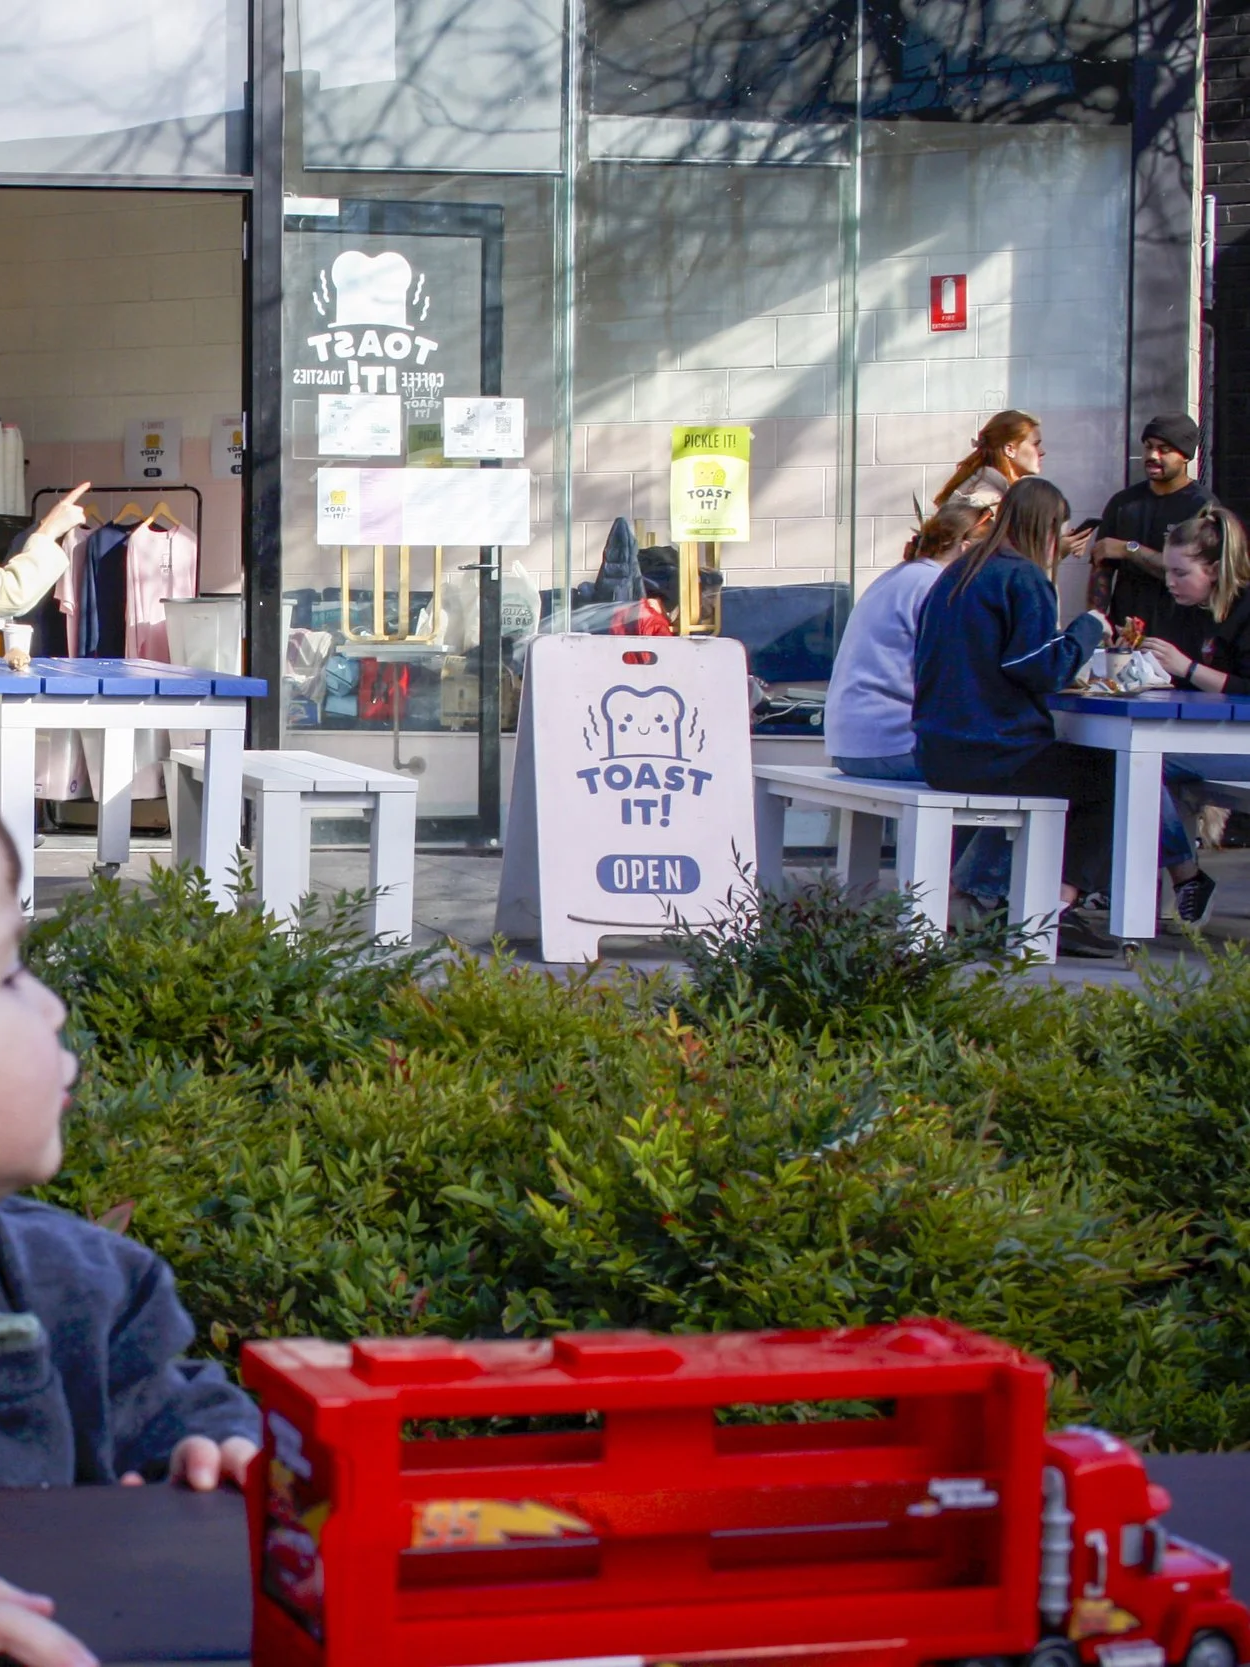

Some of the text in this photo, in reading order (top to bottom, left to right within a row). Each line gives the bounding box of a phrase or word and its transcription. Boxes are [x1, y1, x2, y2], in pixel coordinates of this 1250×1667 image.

[403, 399, 442, 410] TOAST
[415, 408, 430, 419] IT!
[684, 434, 737, 448] PICKLE IT!
[140, 449, 165, 457] TOAST
[687, 488, 732, 500] TOAST
[700, 499, 718, 511] IT!
[576, 763, 713, 796] TOAST
[621, 793, 671, 828] IT!
[613, 858, 682, 890] OPEN
